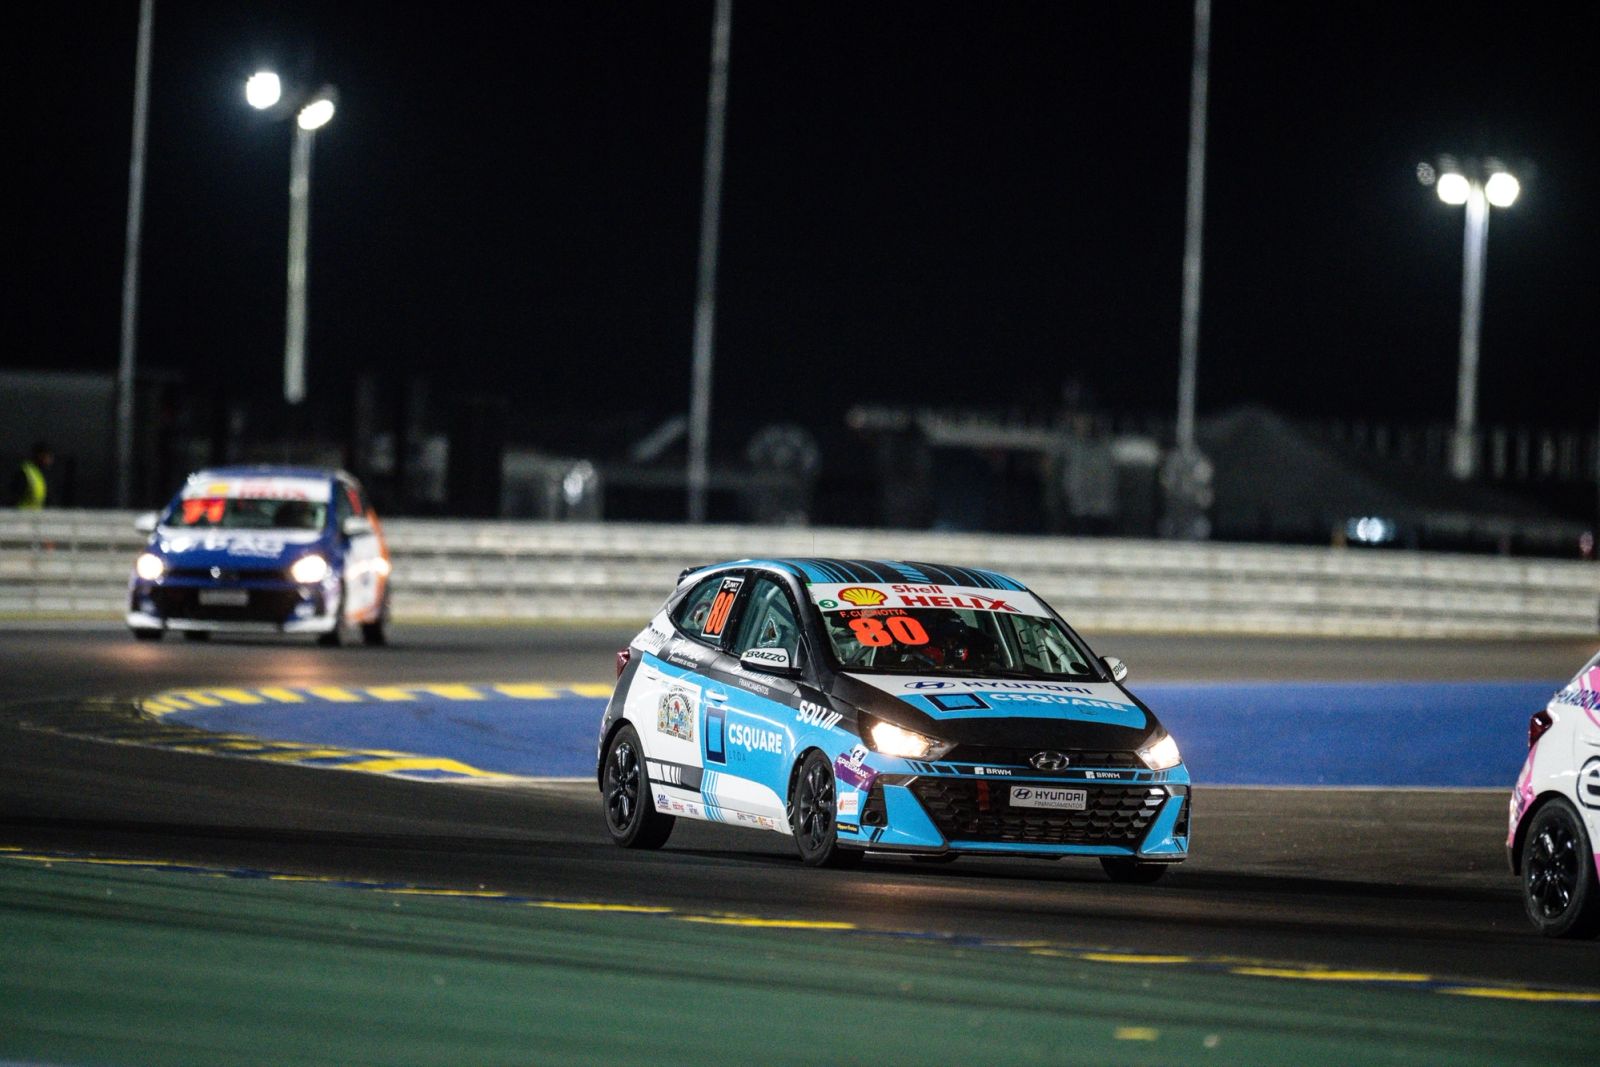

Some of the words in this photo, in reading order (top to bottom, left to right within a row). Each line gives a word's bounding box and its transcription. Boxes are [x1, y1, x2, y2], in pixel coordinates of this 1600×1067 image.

[891, 584, 944, 594] Shell
[898, 595, 1019, 612] HELIX
[705, 591, 735, 635] 80
[848, 616, 930, 647] 80
[746, 651, 787, 662] BRAZZO
[962, 681, 1093, 695] HYUNDAI
[989, 693, 1128, 712] CSQUARE
[728, 723, 783, 754] CSQUARE
[986, 768, 1012, 776] BRWM
[1035, 790, 1084, 801] HYUNDAI
[1034, 801, 1083, 809] FINANCIAMENTOS
